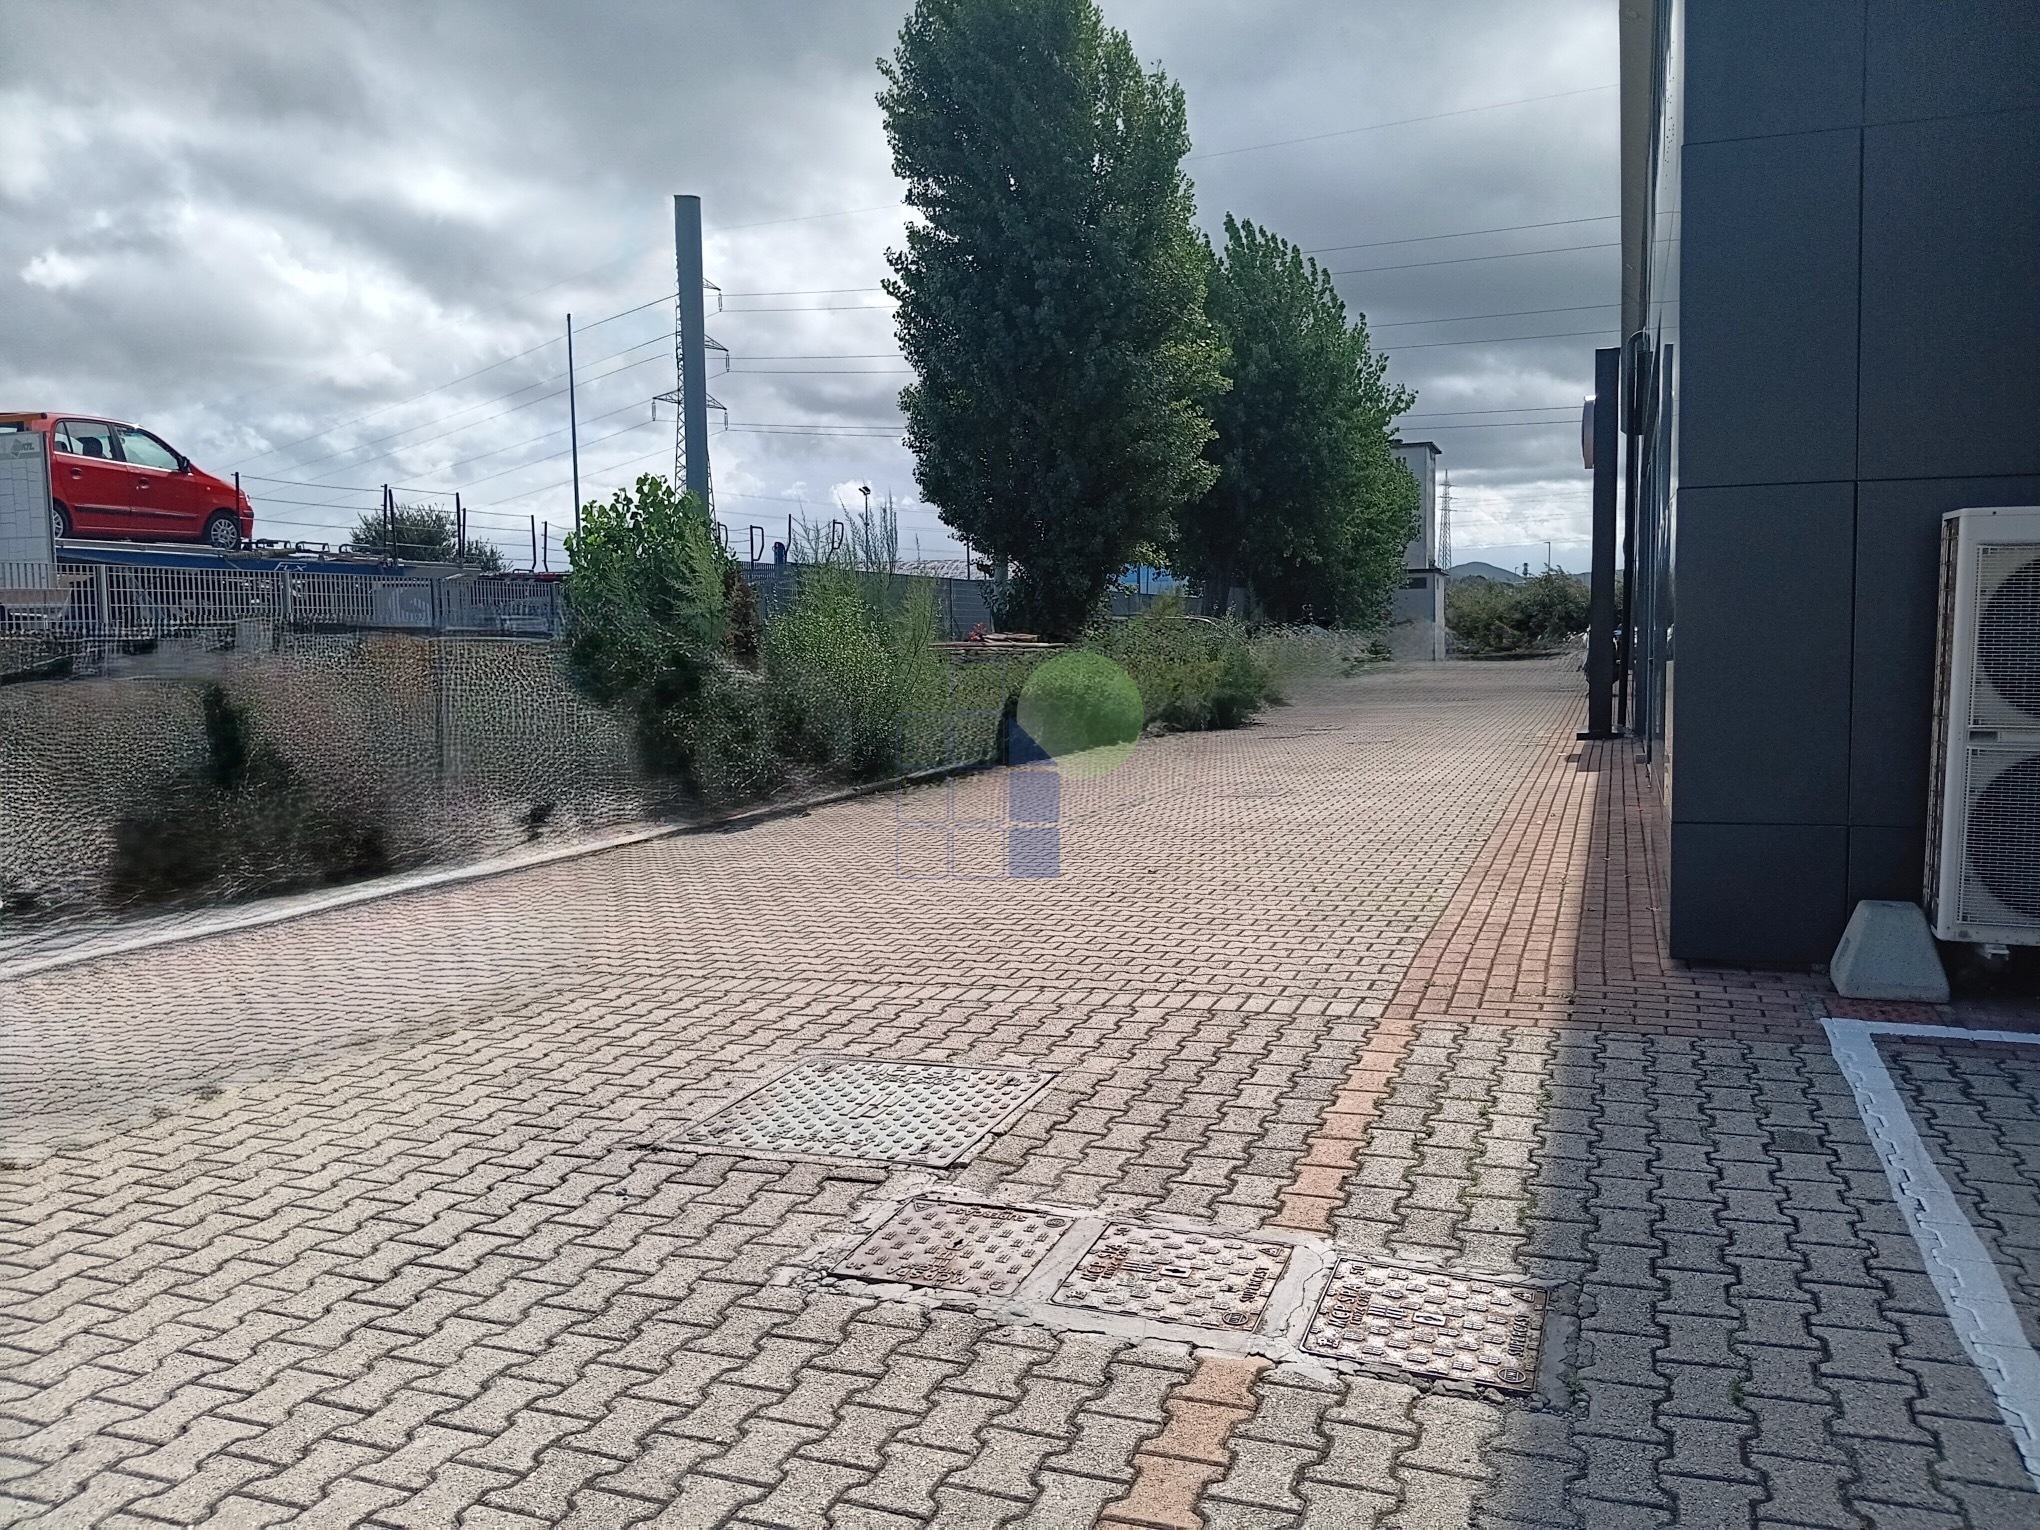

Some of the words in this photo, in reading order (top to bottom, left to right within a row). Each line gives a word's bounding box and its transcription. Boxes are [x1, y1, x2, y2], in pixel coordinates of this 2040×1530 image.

[1080, 1261, 1106, 1282] MCP
[1097, 1244, 1123, 1259] SPA
[1238, 1265, 1270, 1303] SUPERCAST
[1337, 1282, 1362, 1304] SPA
[1327, 1303, 1352, 1329] MCP
[1508, 1313, 1530, 1357] SUPERCAST
